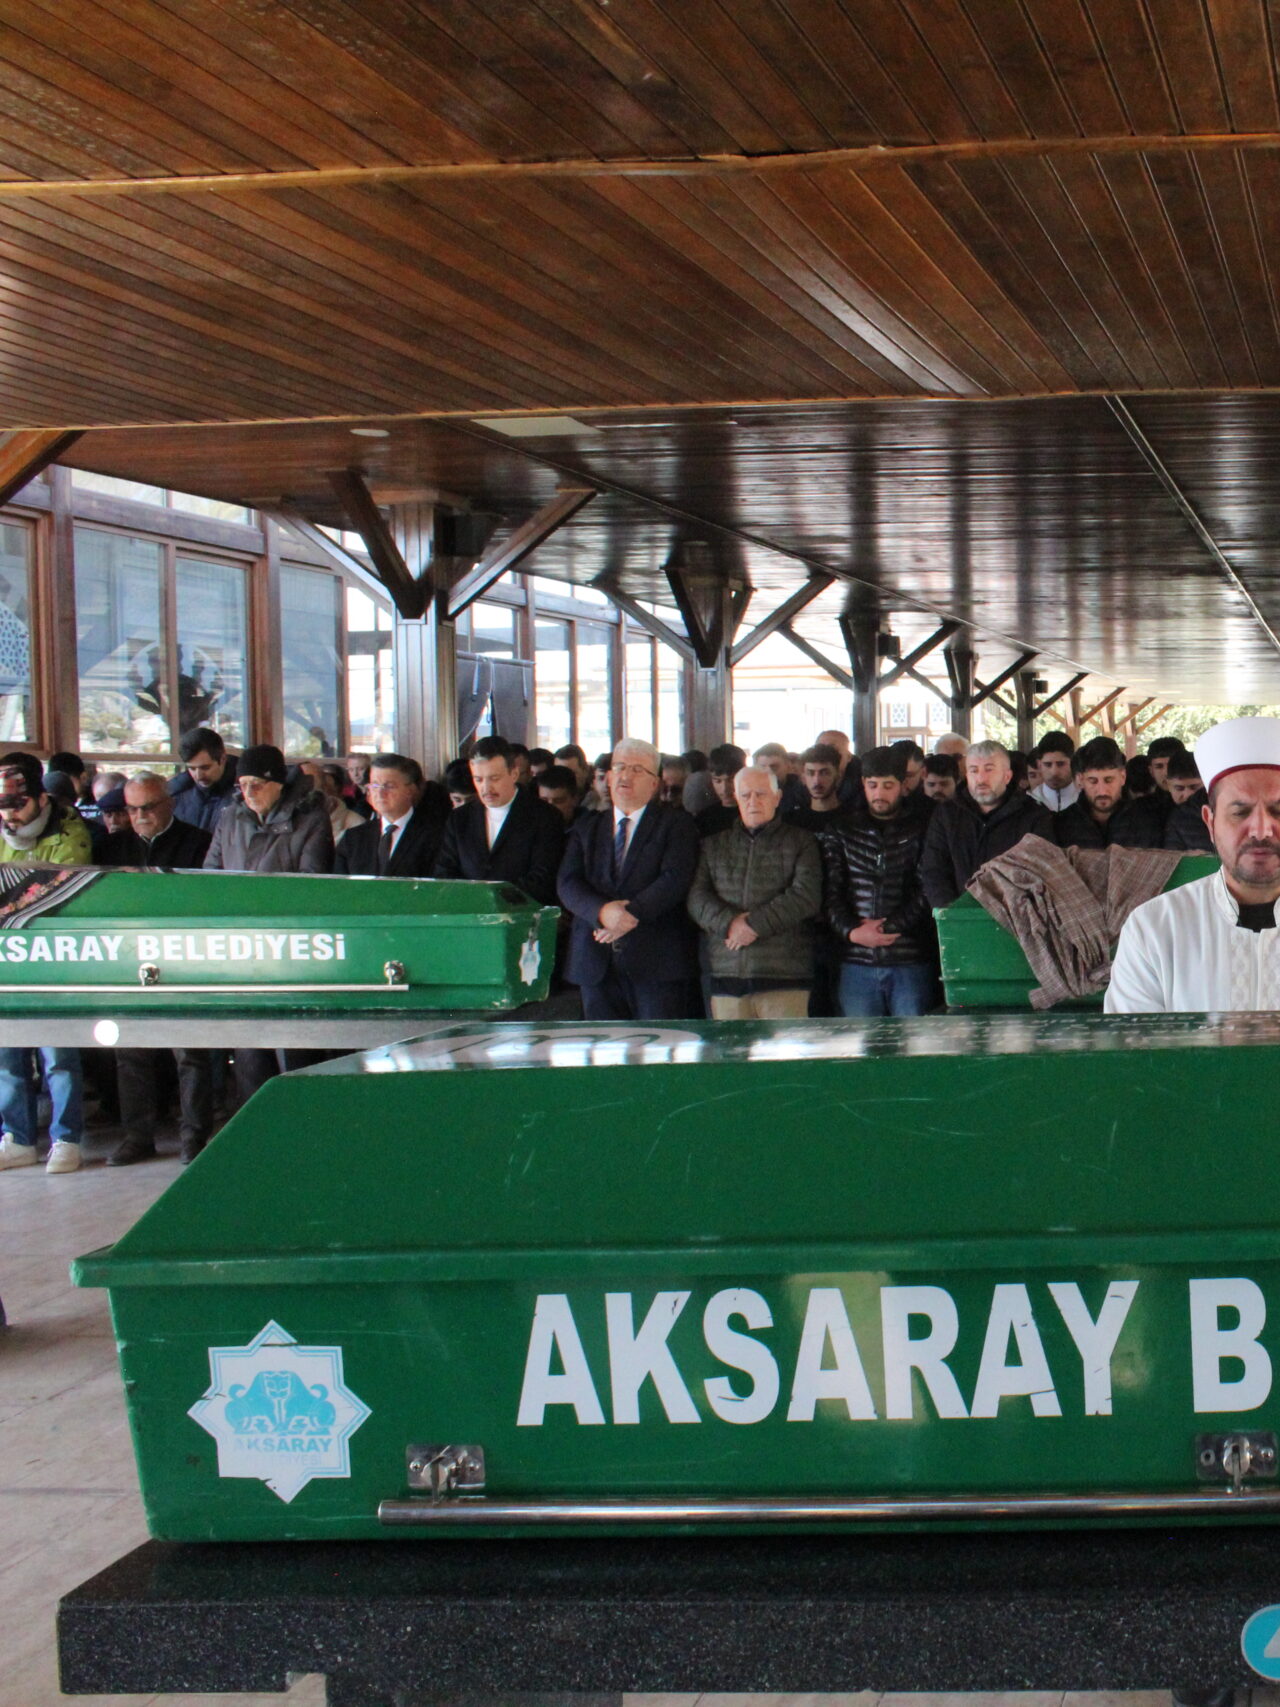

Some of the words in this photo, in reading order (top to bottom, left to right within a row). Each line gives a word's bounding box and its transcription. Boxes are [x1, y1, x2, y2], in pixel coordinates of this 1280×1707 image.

[0, 935, 124, 963] SARAY
[516, 1280, 1140, 1426] AKSARAY
[234, 1438, 332, 1453] AKSARAY
